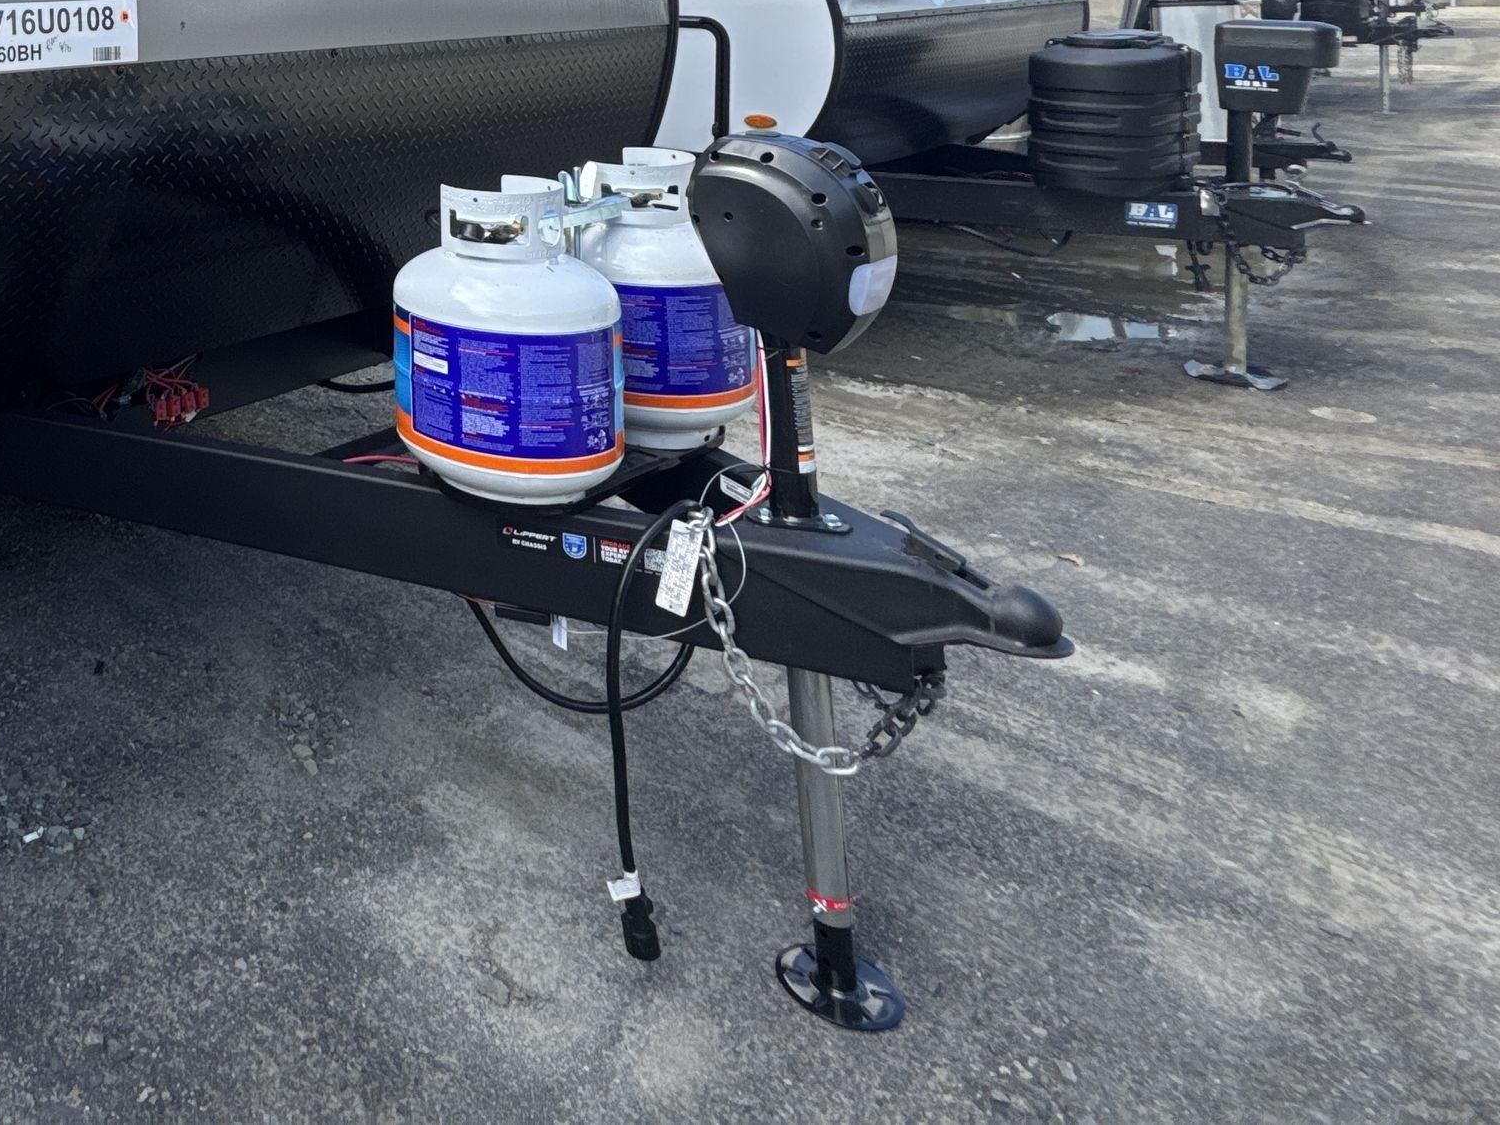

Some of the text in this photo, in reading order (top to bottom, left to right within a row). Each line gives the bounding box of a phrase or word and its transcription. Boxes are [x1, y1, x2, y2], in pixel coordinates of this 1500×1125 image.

[1224, 63, 1279, 82] BAL
[1128, 202, 1174, 219] BAL
[521, 540, 547, 551] CHASSIS
[601, 539, 631, 550] UPGRADE
